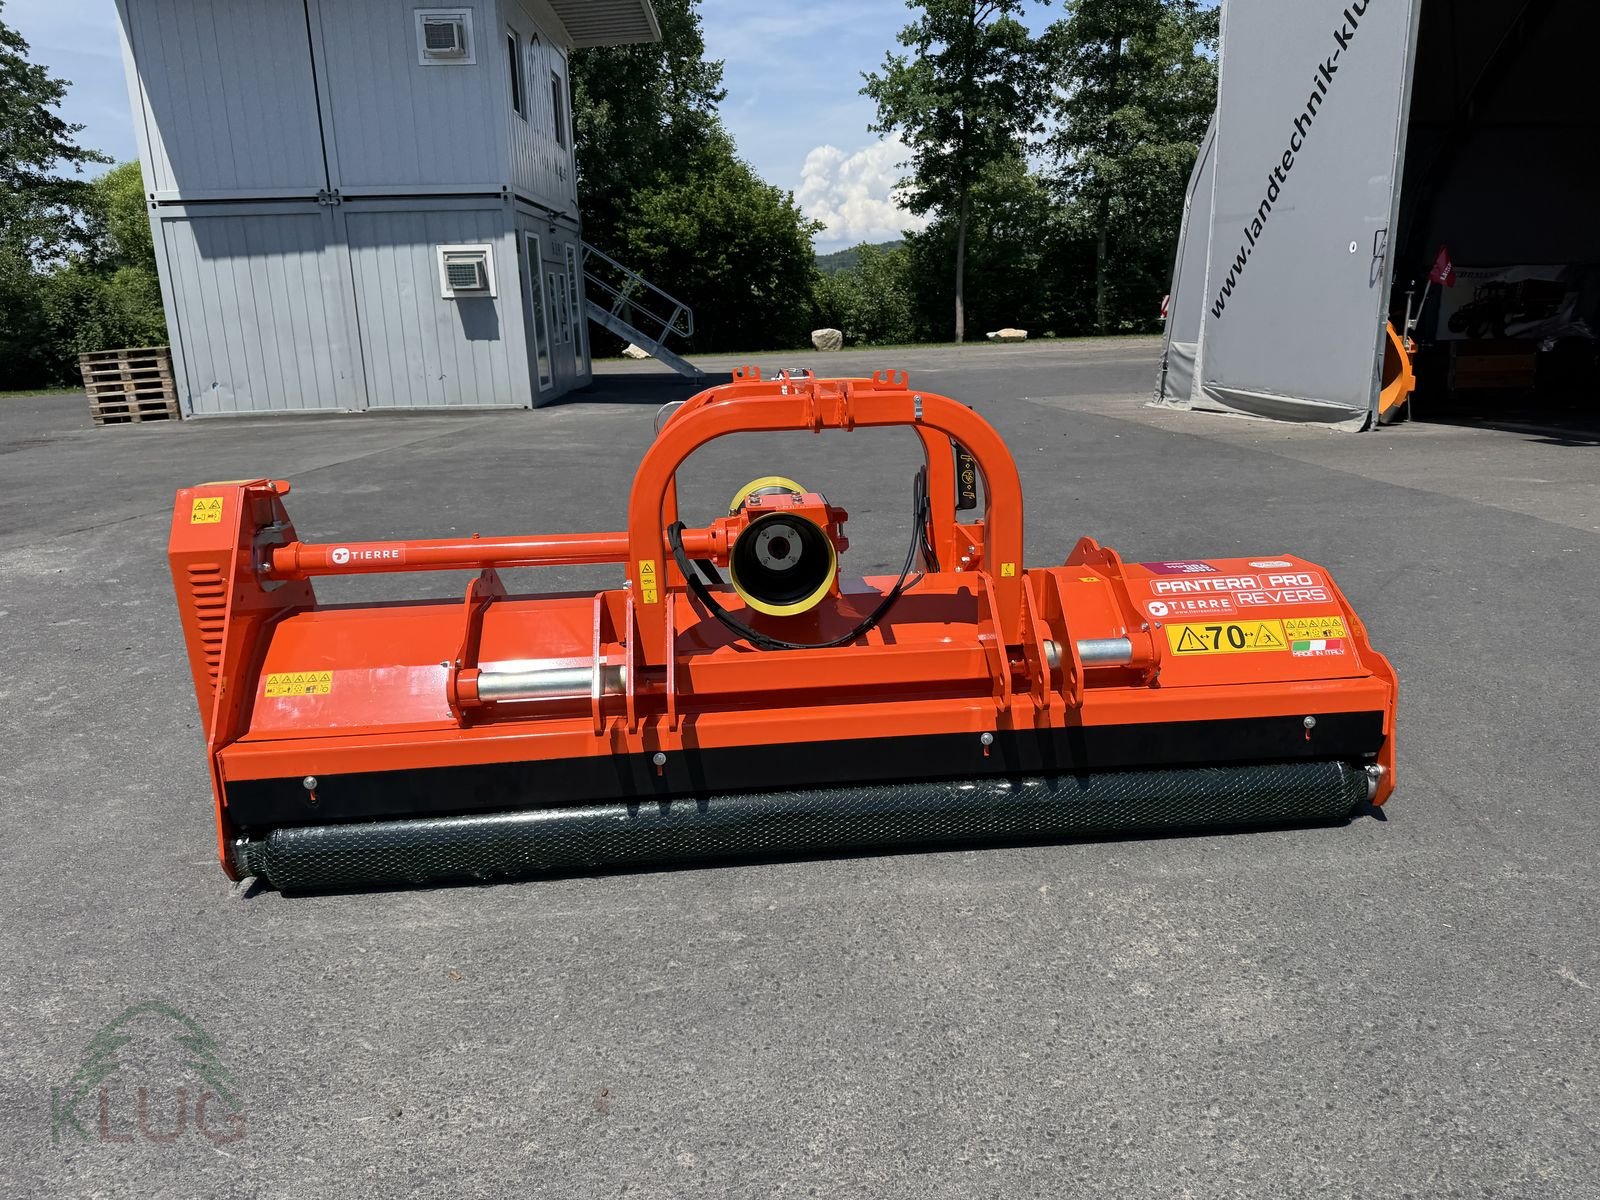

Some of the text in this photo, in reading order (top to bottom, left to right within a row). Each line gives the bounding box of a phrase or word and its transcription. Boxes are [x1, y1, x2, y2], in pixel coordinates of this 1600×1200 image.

[351, 549, 399, 560] TIERRE
[1156, 574, 1313, 594] PANTERA PRO
[1168, 599, 1231, 610] TIERRE
[1237, 589, 1327, 605] REVERS
[1205, 625, 1246, 650] 70
